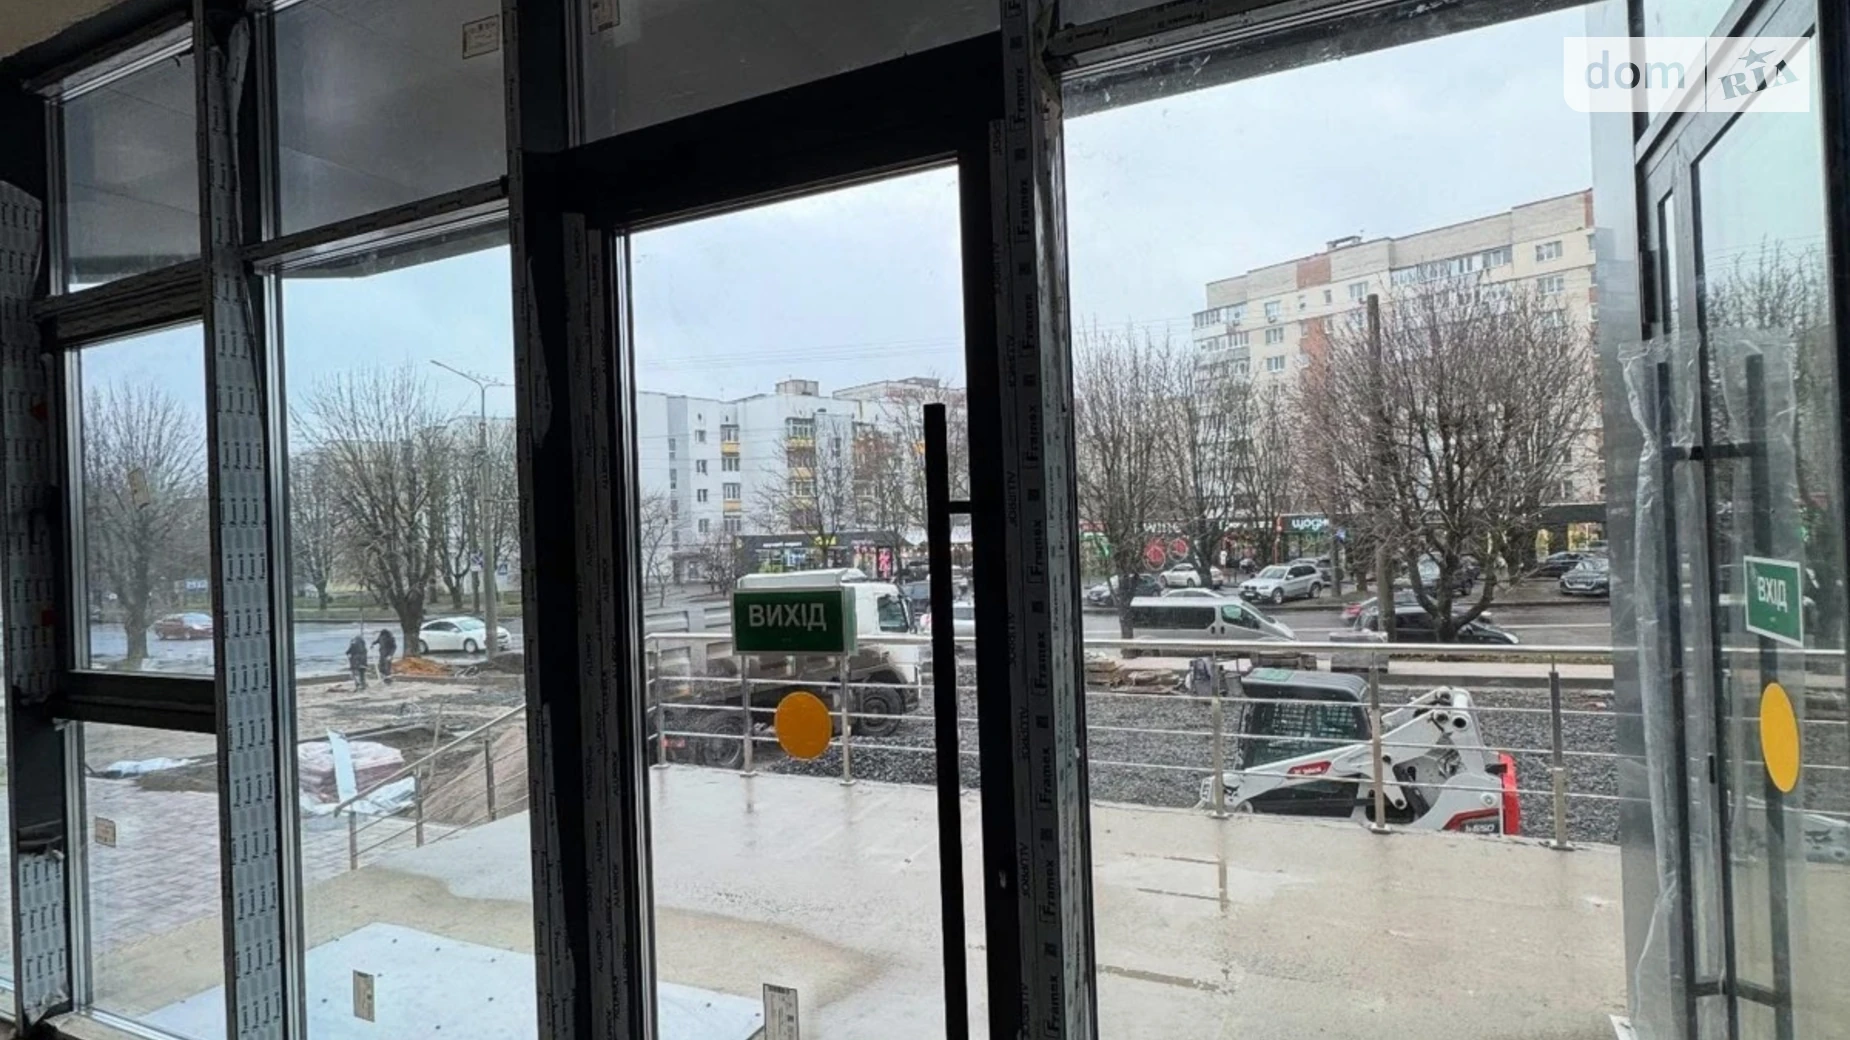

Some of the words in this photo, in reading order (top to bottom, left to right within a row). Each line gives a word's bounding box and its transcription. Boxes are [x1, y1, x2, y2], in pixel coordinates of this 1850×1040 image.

[1014, 67, 1025, 124] Framex
[1018, 180, 1029, 235] Framex
[1023, 293, 1034, 349] Framex
[1027, 405, 1039, 461] Framex
[1031, 519, 1042, 576] Framex
[749, 603, 827, 632] ВИХІД
[1756, 576, 1788, 613] ВХІД
[1034, 631, 1047, 689] Framex
[1039, 747, 1052, 803] Framex
[1042, 859, 1055, 917] Framex
[1047, 975, 1060, 1032] Framex
